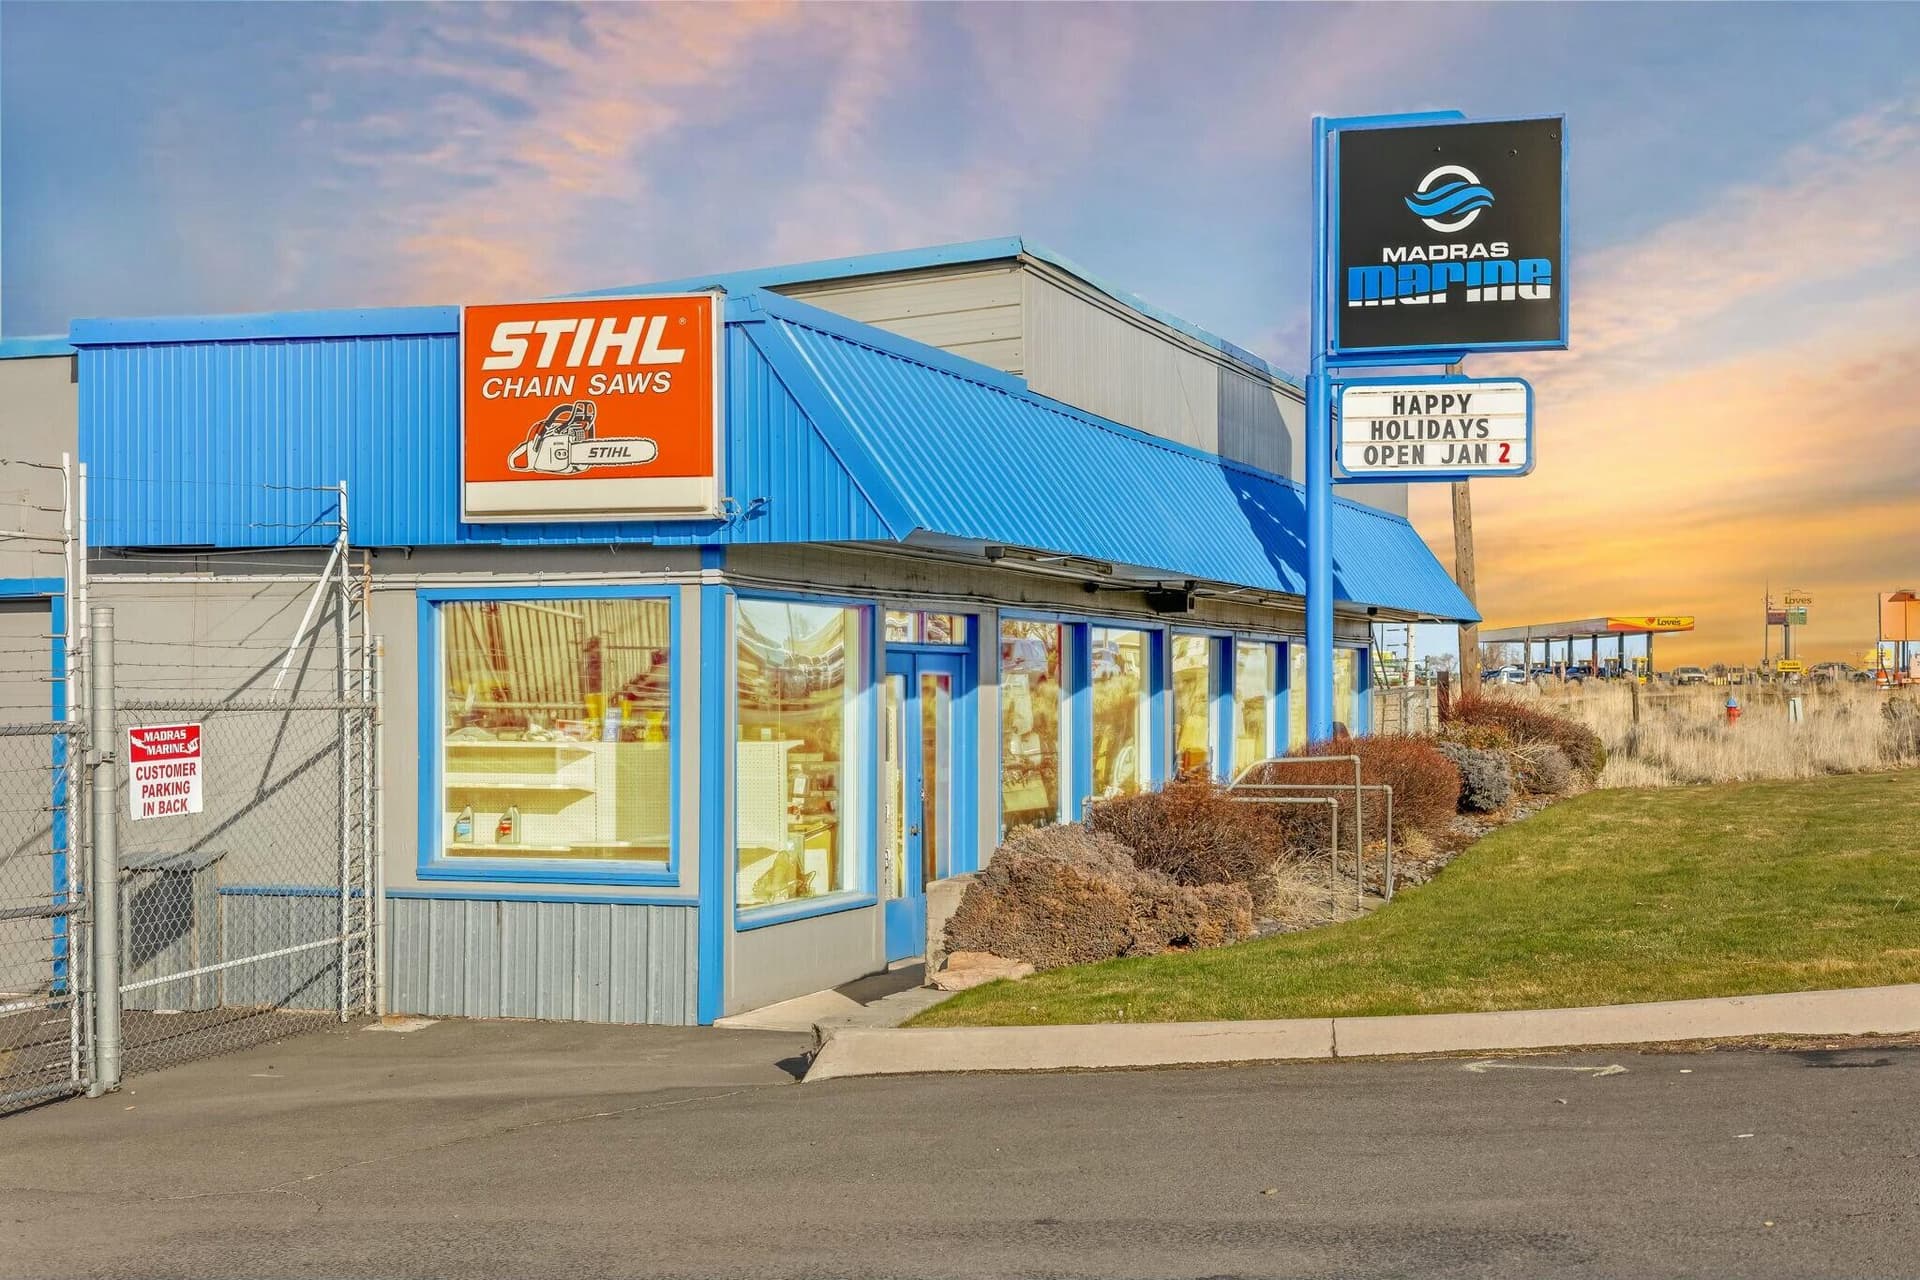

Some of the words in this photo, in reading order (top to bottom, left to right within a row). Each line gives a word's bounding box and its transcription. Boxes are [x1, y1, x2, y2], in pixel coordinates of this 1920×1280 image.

[1382, 242, 1509, 263] MADRAS
[1348, 258, 1552, 307] marine
[481, 315, 686, 370] STIHL
[482, 375, 576, 399] CHAIN
[588, 371, 672, 396] SAWS
[1392, 393, 1473, 415] HAPPY
[1371, 418, 1489, 441] HOLIDAYS
[587, 446, 632, 458] STIHL
[1363, 444, 1425, 465] OPEN
[1441, 443, 1488, 465] JAN
[1498, 442, 1511, 463] 2
[143, 729, 187, 742] MADRAS
[146, 743, 186, 756] MARINE
[135, 762, 197, 781] CUSTOMER
[141, 780, 191, 799] PARKING
[143, 802, 155, 817] IN
[158, 798, 188, 815] BACK
